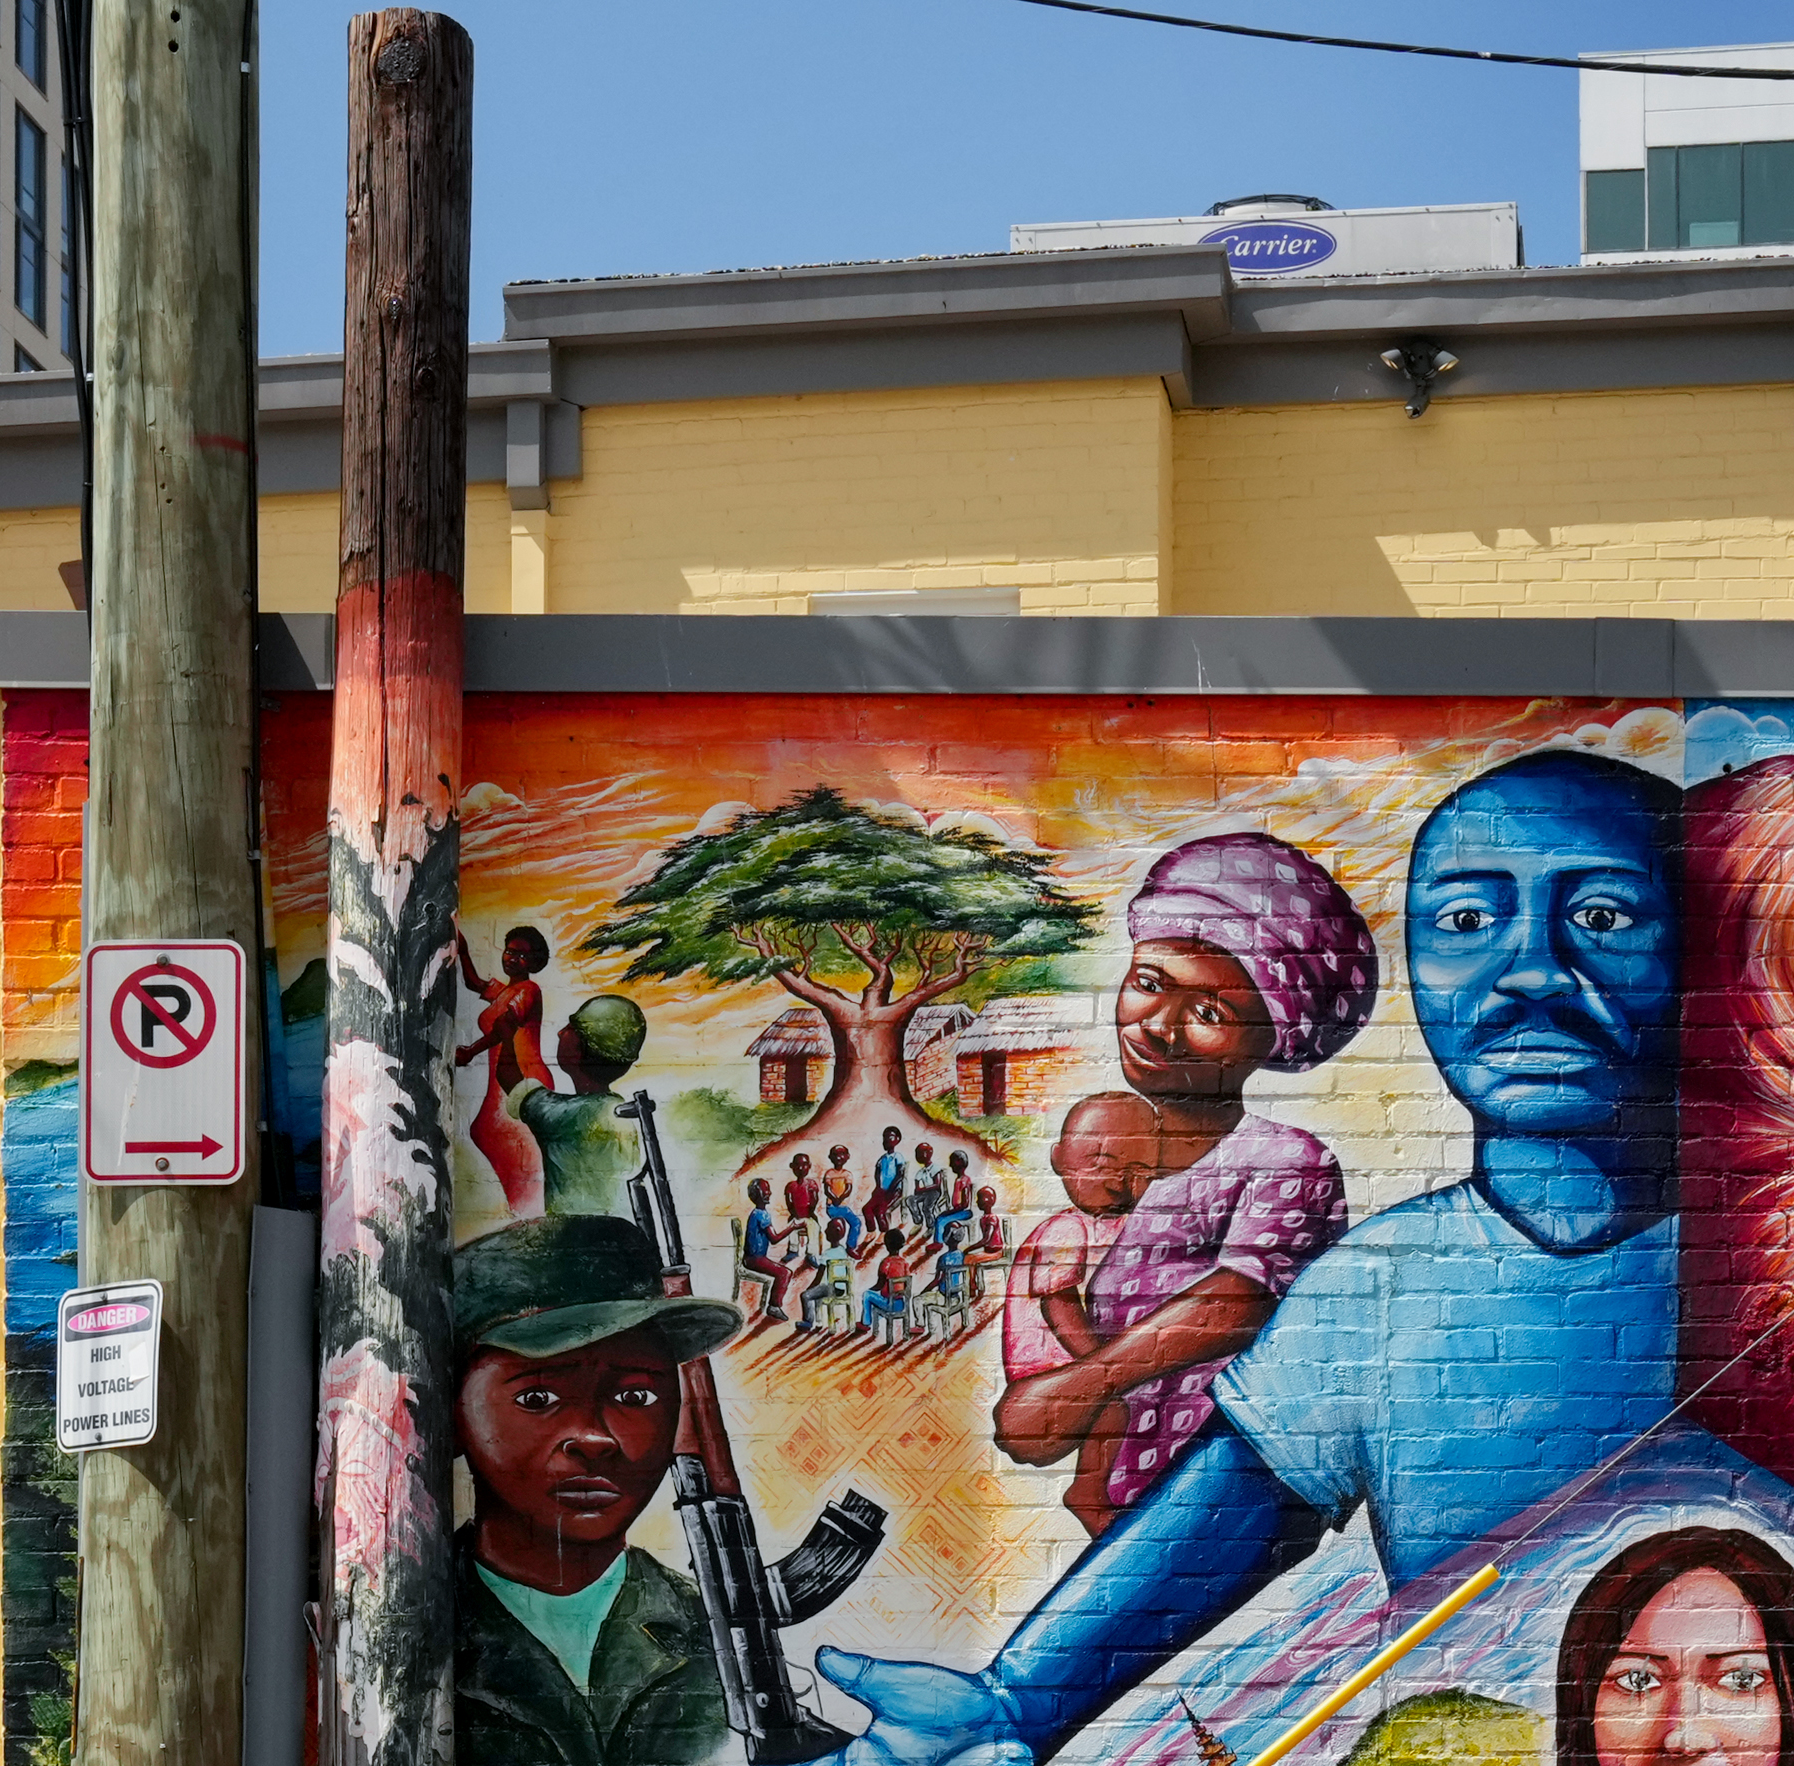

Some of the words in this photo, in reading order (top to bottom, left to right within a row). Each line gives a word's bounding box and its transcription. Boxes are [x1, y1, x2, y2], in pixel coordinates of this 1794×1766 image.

[78, 1307, 137, 1330] DANGER
[91, 1345, 121, 1363] HIGH
[78, 1377, 135, 1398] VOLTAGE
[63, 1414, 108, 1433] POWER
[113, 1408, 150, 1427] LINES
